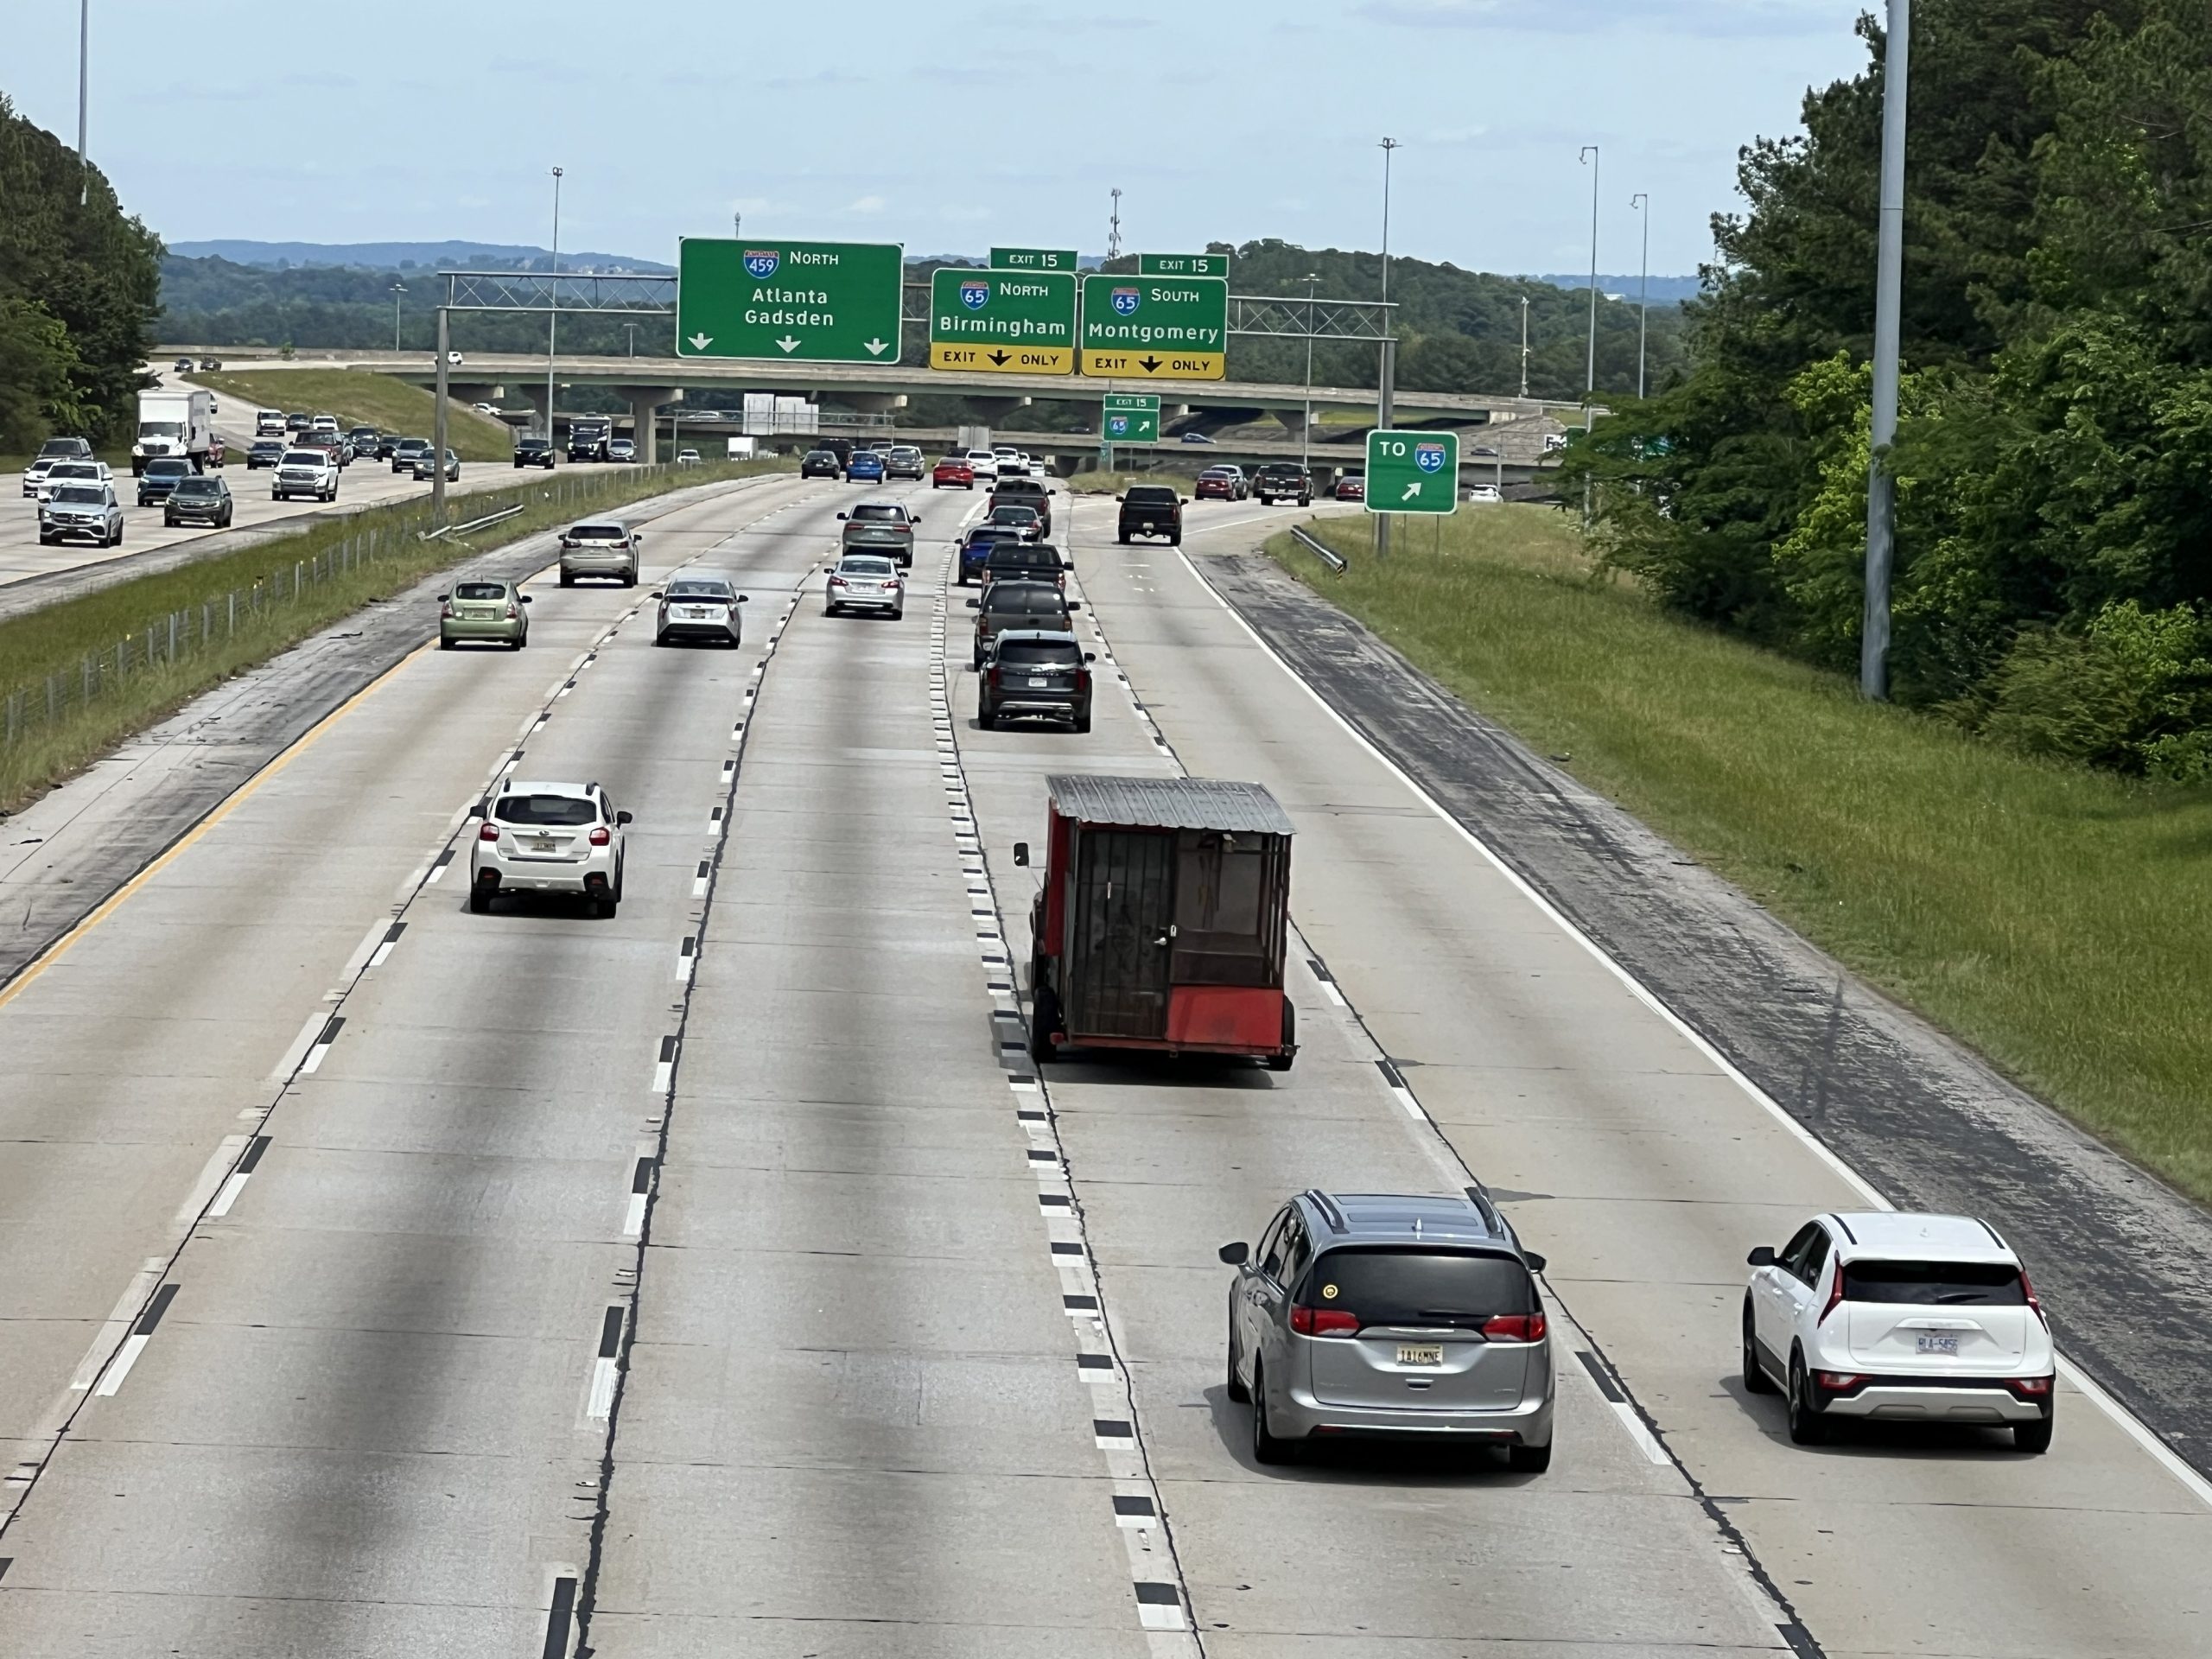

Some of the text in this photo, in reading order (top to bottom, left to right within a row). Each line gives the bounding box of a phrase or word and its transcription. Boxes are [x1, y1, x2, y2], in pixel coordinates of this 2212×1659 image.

[749, 258, 774, 272] 459
[790, 251, 839, 265] NORTH
[1009, 254, 1058, 267] EXIT 15
[1160, 259, 1208, 273] EXIT 15
[752, 288, 828, 304] Atlanta
[965, 289, 984, 303] 65
[1000, 283, 1048, 296] NORTH
[1151, 289, 1199, 302] SOUTH
[1116, 296, 1135, 309] 65
[745, 309, 834, 326] Gadsden
[940, 315, 1065, 337] Birmingham
[1089, 323, 1218, 344] Montgomery
[944, 351, 1059, 365] EXIT ONLY
[1095, 358, 1210, 371] EXIT ONLY
[1136, 398, 1147, 407] 15
[1113, 421, 1126, 431] 65
[1379, 442, 1406, 456] TO
[1420, 452, 1440, 467] 65
